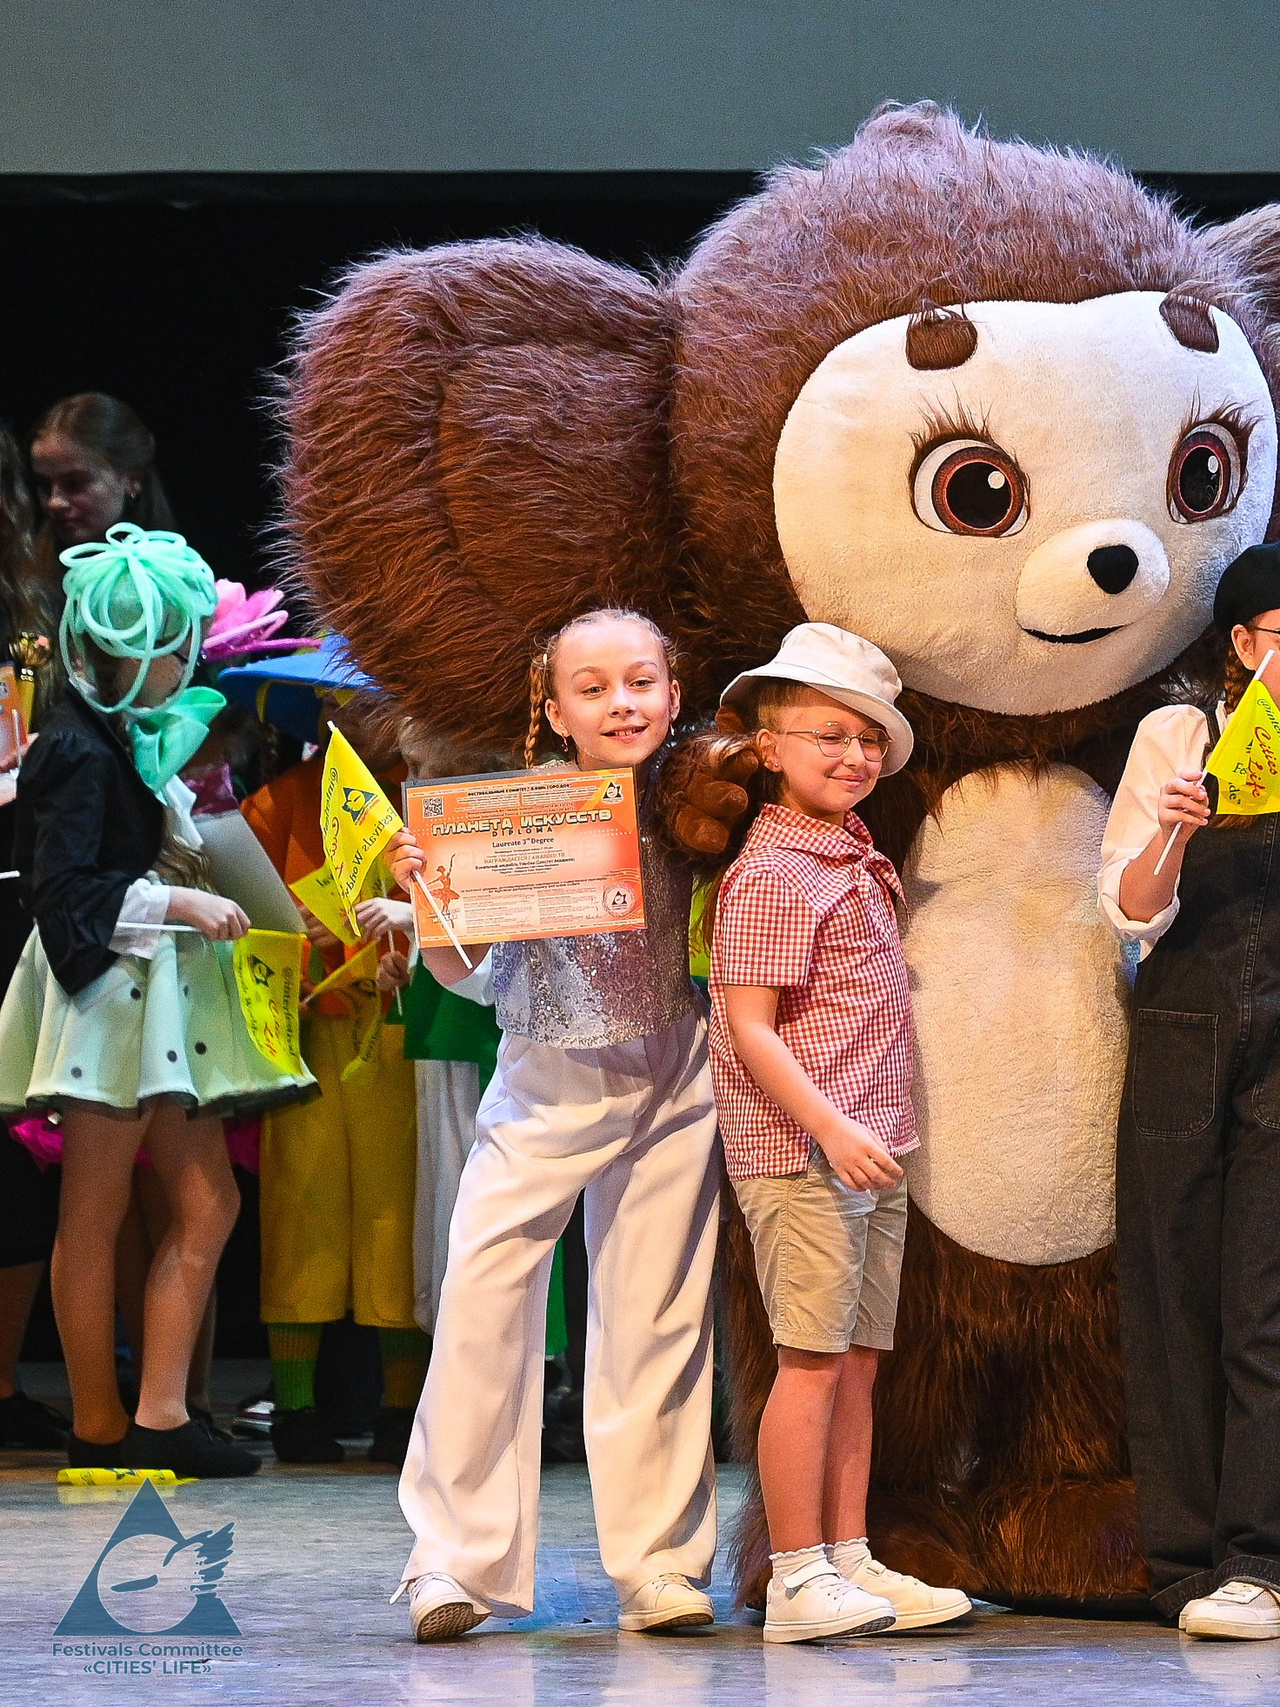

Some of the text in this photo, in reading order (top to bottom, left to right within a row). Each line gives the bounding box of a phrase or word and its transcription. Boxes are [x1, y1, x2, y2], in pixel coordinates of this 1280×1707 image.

[1246, 757, 1266, 798] Life
[432, 817, 514, 836] ПЛАНЕТА
[520, 808, 612, 828] ИСКУССТВ
[492, 826, 553, 837] DIPLOMA
[492, 840, 521, 848] Laureate
[531, 836, 554, 845] Degree
